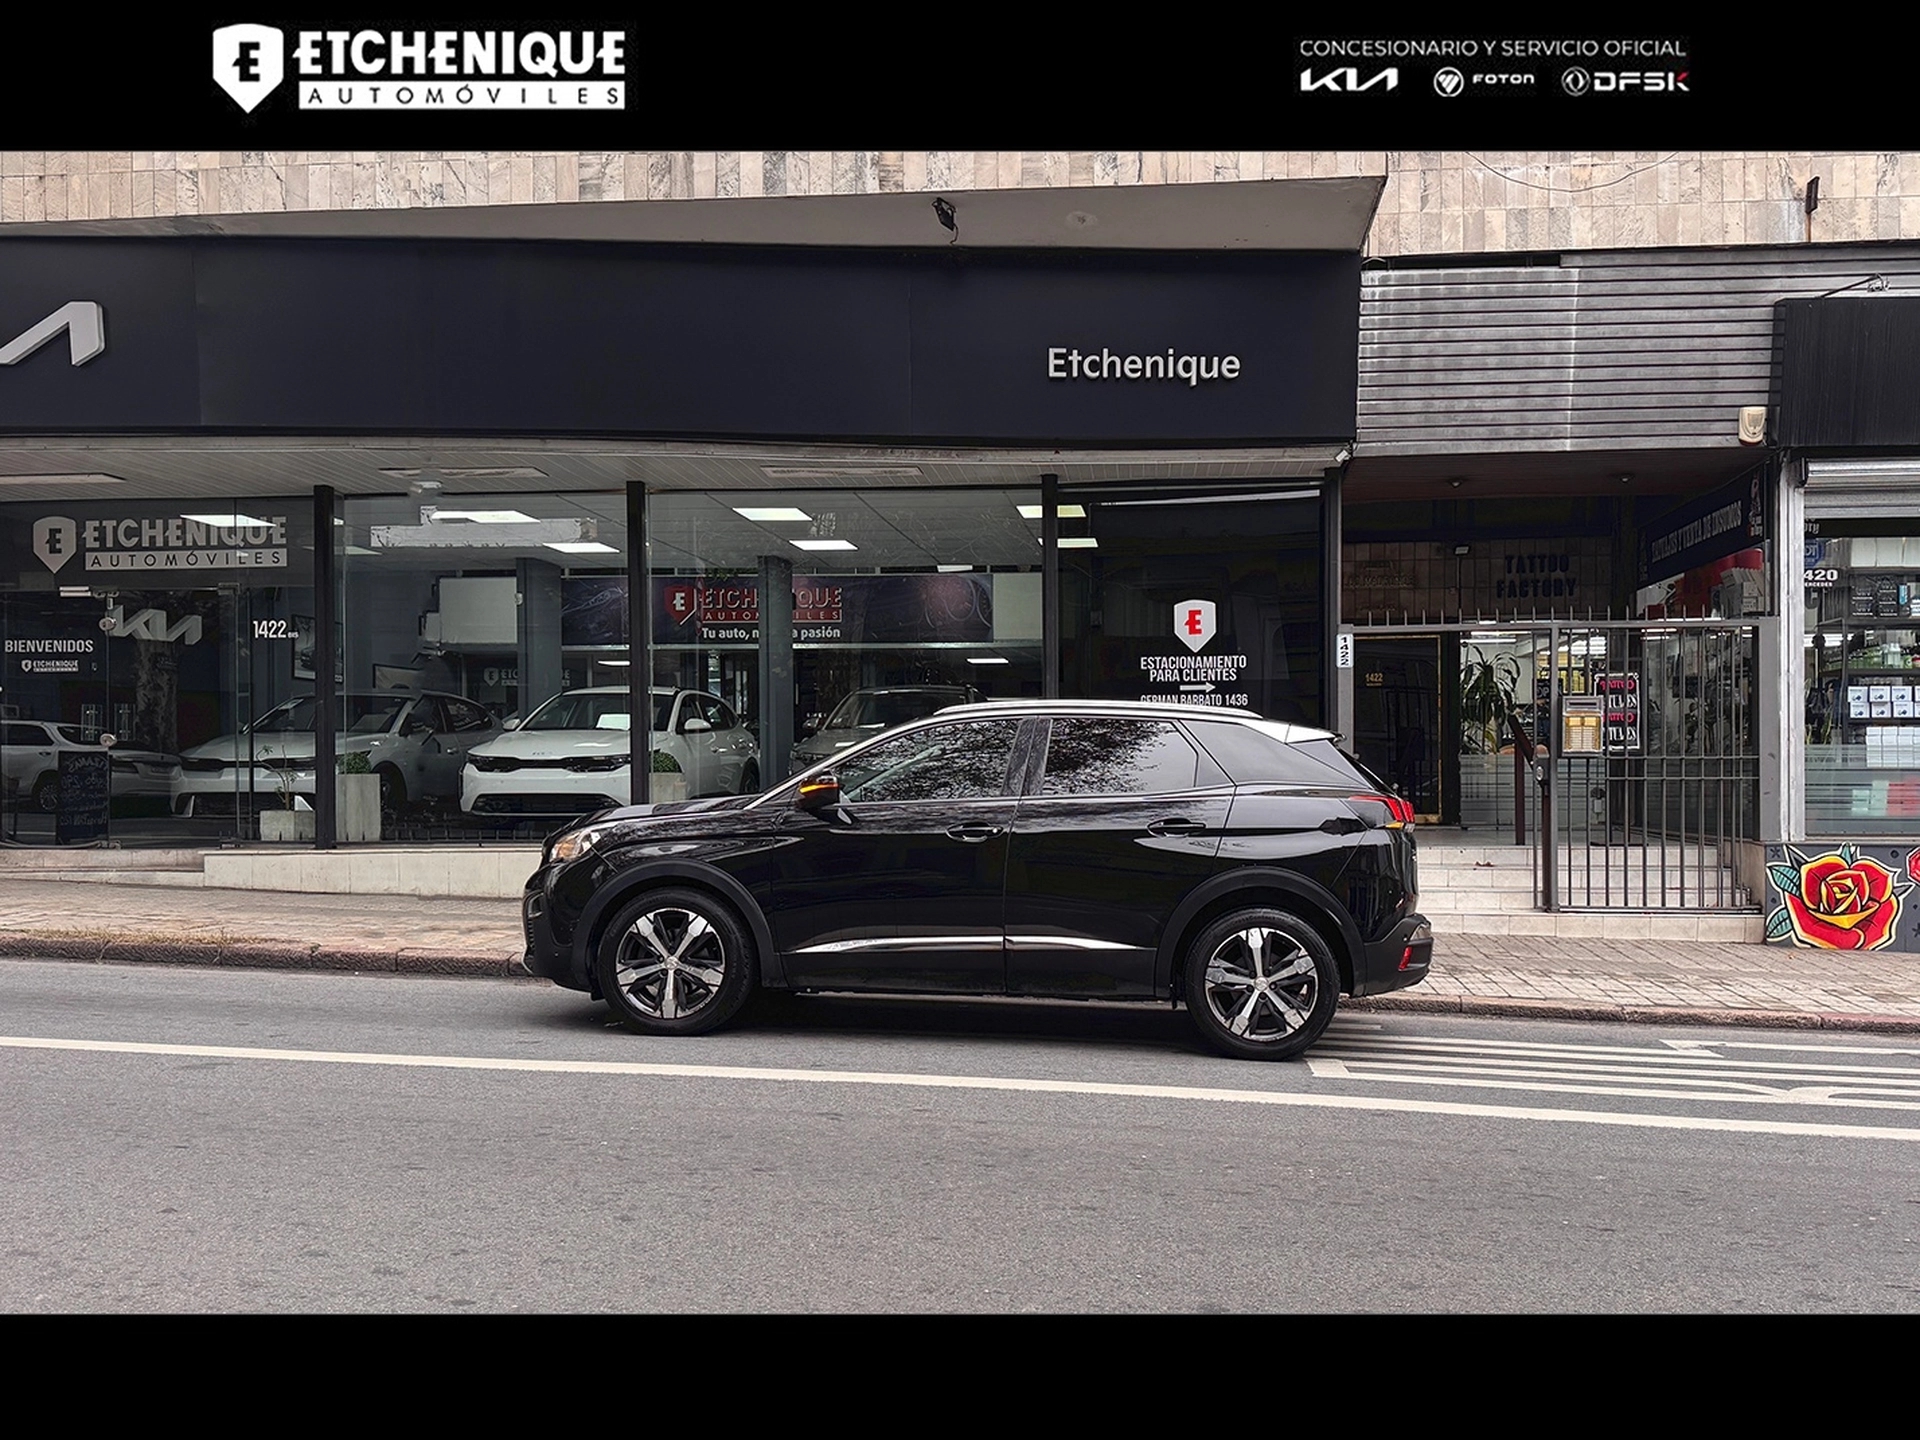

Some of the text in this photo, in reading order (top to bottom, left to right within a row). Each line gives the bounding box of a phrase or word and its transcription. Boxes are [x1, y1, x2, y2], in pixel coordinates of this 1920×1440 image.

[1048, 347, 1241, 387] Etchenique
[81, 516, 287, 548] ETCHENIQUE
[91, 549, 281, 567] AUTOMÓVILES
[1505, 554, 1569, 574] TATTOO
[1804, 569, 1838, 581] 420
[1496, 578, 1577, 598] FACTORY
[252, 619, 287, 639] 1422
[1184, 609, 1202, 635] E
[702, 628, 716, 639] Tu
[718, 627, 750, 640] auto,
[801, 626, 840, 641] pasión
[4, 639, 94, 653] BIENVENIDOS
[1340, 636, 1349, 666] 1422
[1140, 655, 1247, 670] ESTACIONAMIENTO
[1150, 668, 1237, 682] PARA CLIENTES
[1225, 694, 1249, 706] 1436
